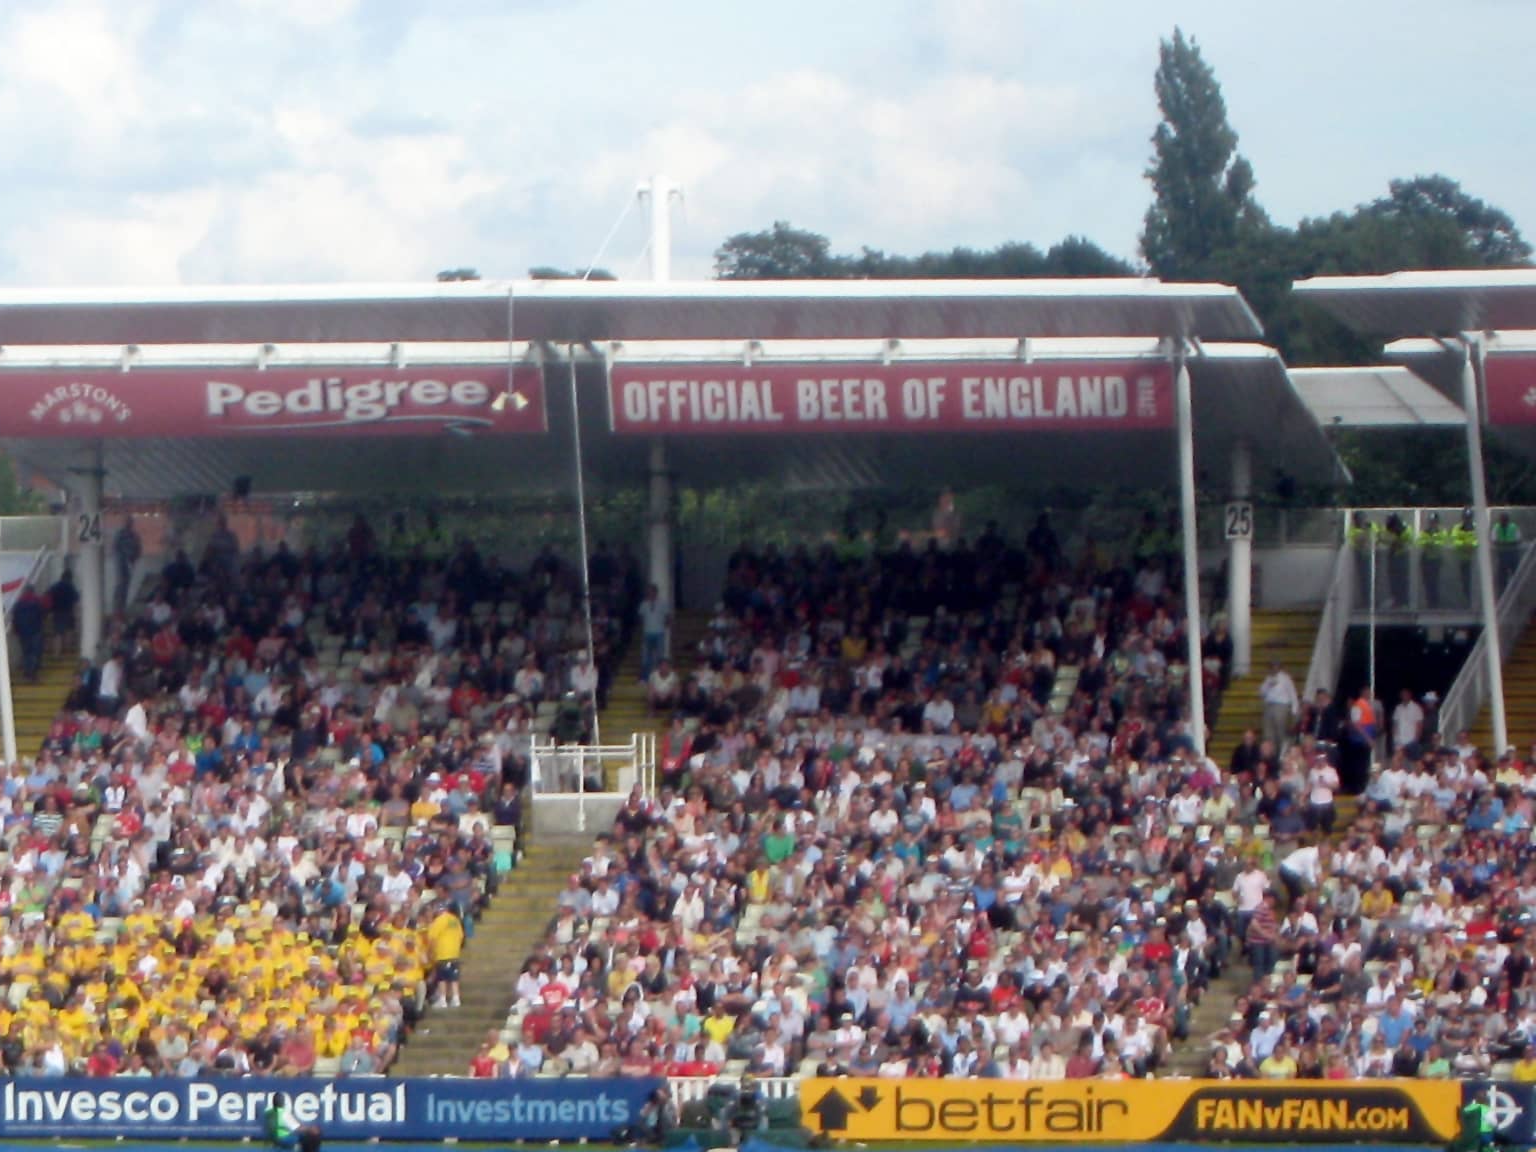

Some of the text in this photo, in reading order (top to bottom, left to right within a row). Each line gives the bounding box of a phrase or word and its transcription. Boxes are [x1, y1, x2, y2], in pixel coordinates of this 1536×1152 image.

[206, 377, 489, 422] Pedigree
[623, 380, 783, 422] OFFICIAL
[798, 379, 888, 420] BEER
[902, 378, 946, 420] OF
[964, 376, 1128, 419] ENGLAND
[80, 513, 102, 542] 24
[1227, 503, 1252, 535] 25
[5, 1081, 180, 1121] Invesco
[426, 1092, 630, 1124] Investments
[894, 1086, 1128, 1133] betfair
